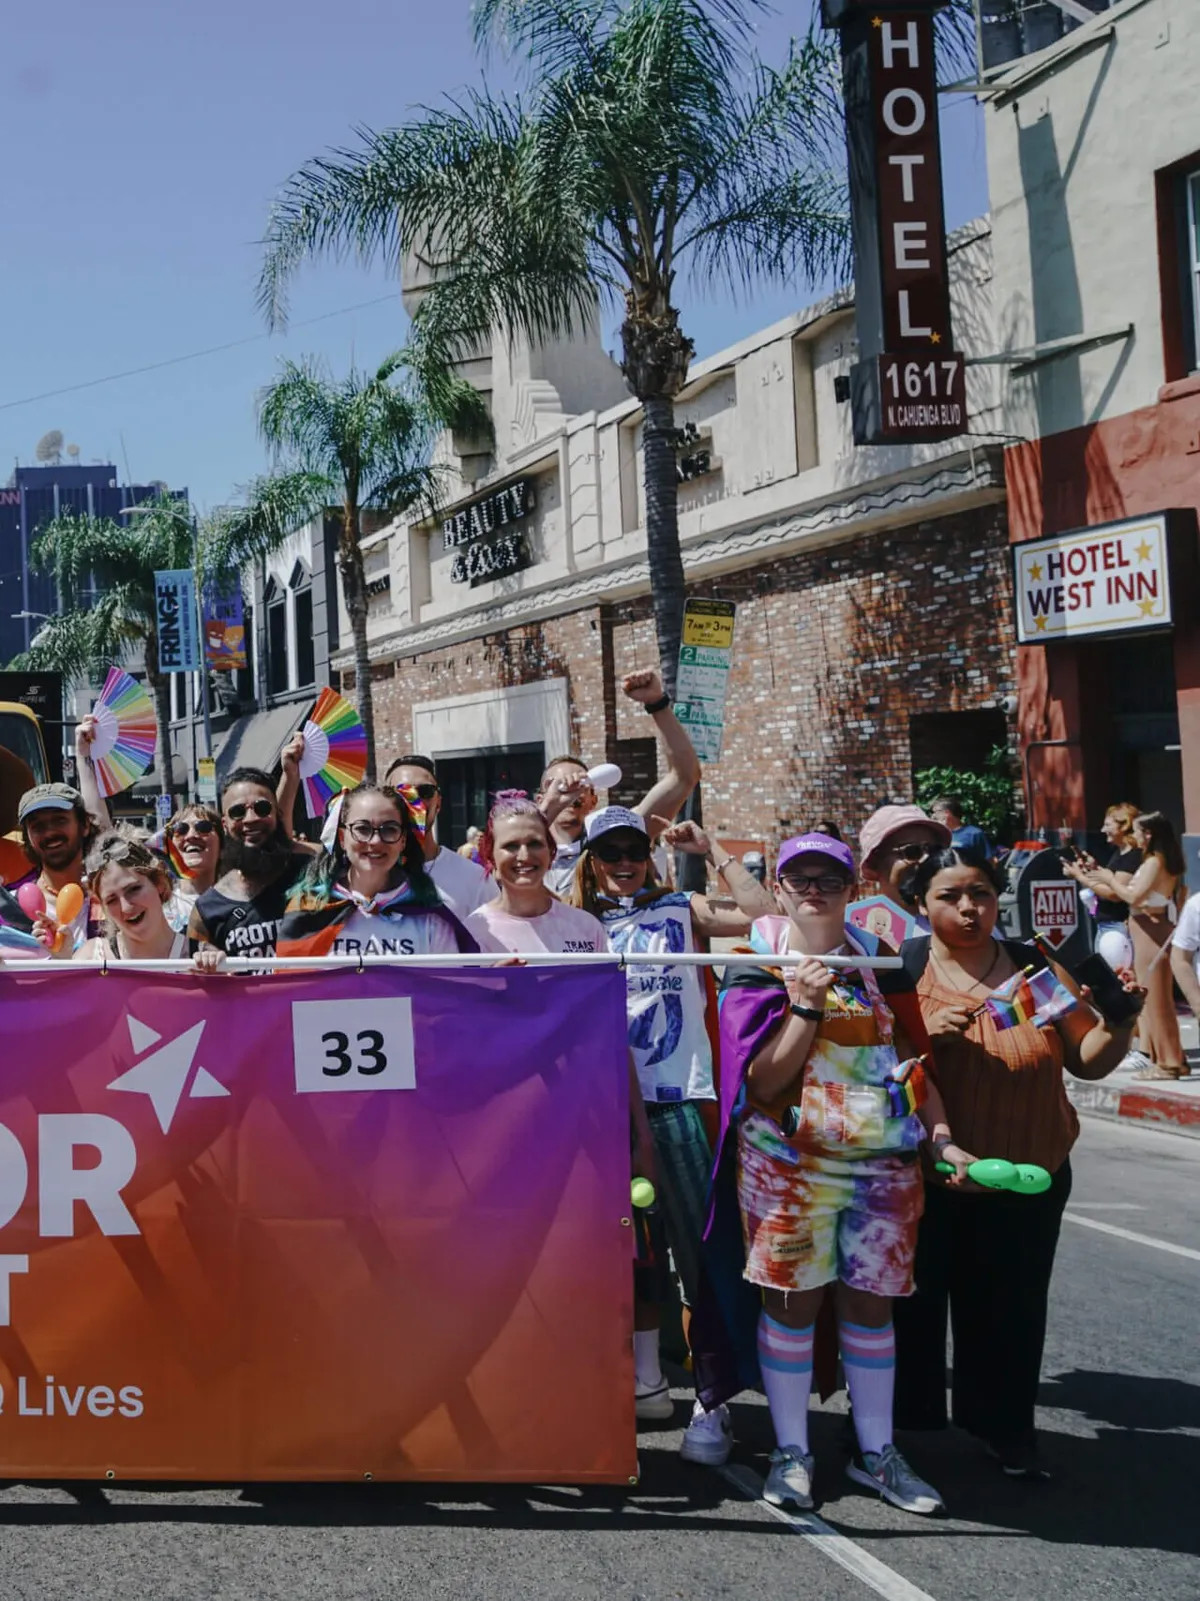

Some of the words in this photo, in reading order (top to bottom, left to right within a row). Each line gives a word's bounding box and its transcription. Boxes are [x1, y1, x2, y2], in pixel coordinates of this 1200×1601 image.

[881, 21, 932, 338] HOTEL
[886, 360, 959, 399] 1617
[888, 406, 898, 427] N.
[897, 404, 940, 427] CAHUENGA
[940, 404, 961, 425] BLVD
[443, 481, 526, 550] BEAUTY
[1047, 540, 1131, 581] HOTEL
[1027, 580, 1096, 617] WEST
[1106, 569, 1158, 605] INN
[157, 584, 182, 668] FRINGE
[681, 647, 693, 661] 2
[676, 704, 688, 718] 2
[1036, 889, 1074, 913] ATM
[1036, 913, 1074, 926] HERE
[225, 919, 283, 951] PROT
[331, 938, 415, 956] TRANS
[321, 1030, 388, 1077] 33
[17, 1375, 144, 1417] Lives
